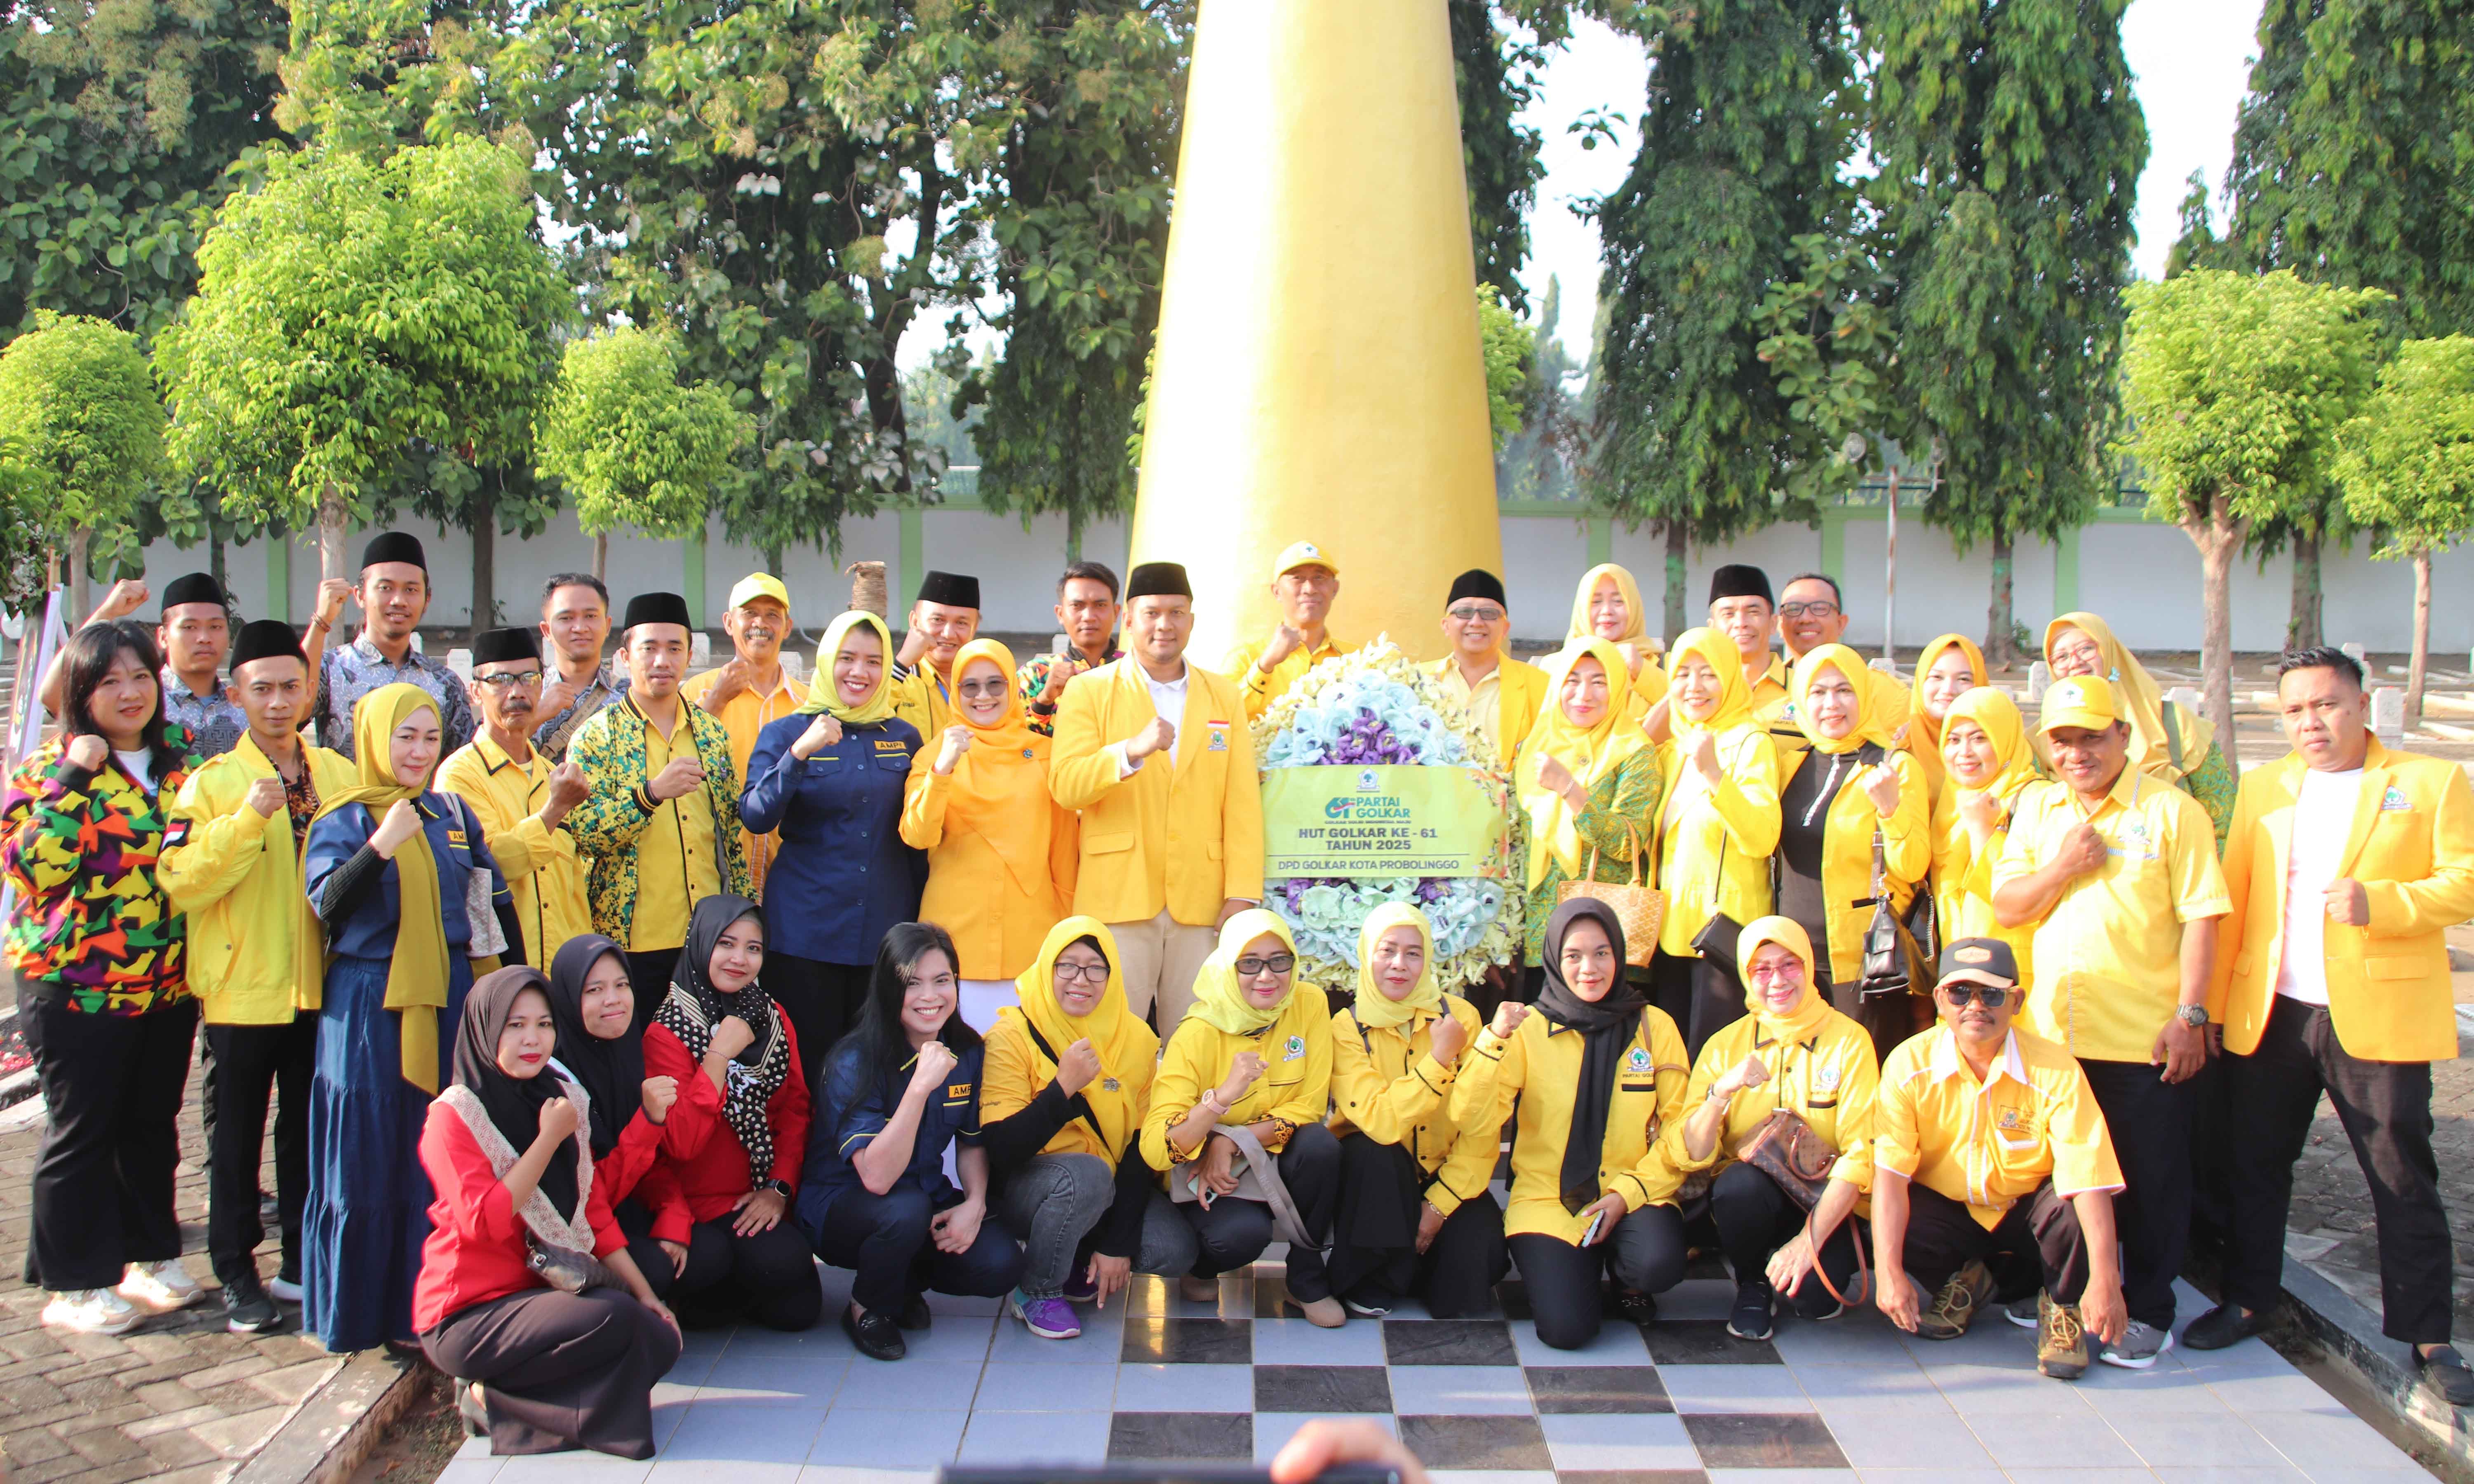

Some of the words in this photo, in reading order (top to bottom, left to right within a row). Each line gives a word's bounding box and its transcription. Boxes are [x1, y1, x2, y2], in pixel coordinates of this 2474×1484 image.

[1357, 797, 1400, 806] PARTAI
[1357, 808, 1411, 818] GOLKAR
[1299, 829, 1325, 838] HUT
[1329, 828, 1386, 837] GOLKAR
[1391, 828, 1410, 837] KE
[1420, 828, 1437, 838] 61
[1326, 841, 1372, 850] TAHUN
[1376, 840, 1411, 850] 2025
[1279, 861, 1300, 869] DPD
[1303, 861, 1346, 869] GOLKAR
[1350, 861, 1378, 869] KOTA
[1380, 860, 1459, 869] PROBOLINGGO
